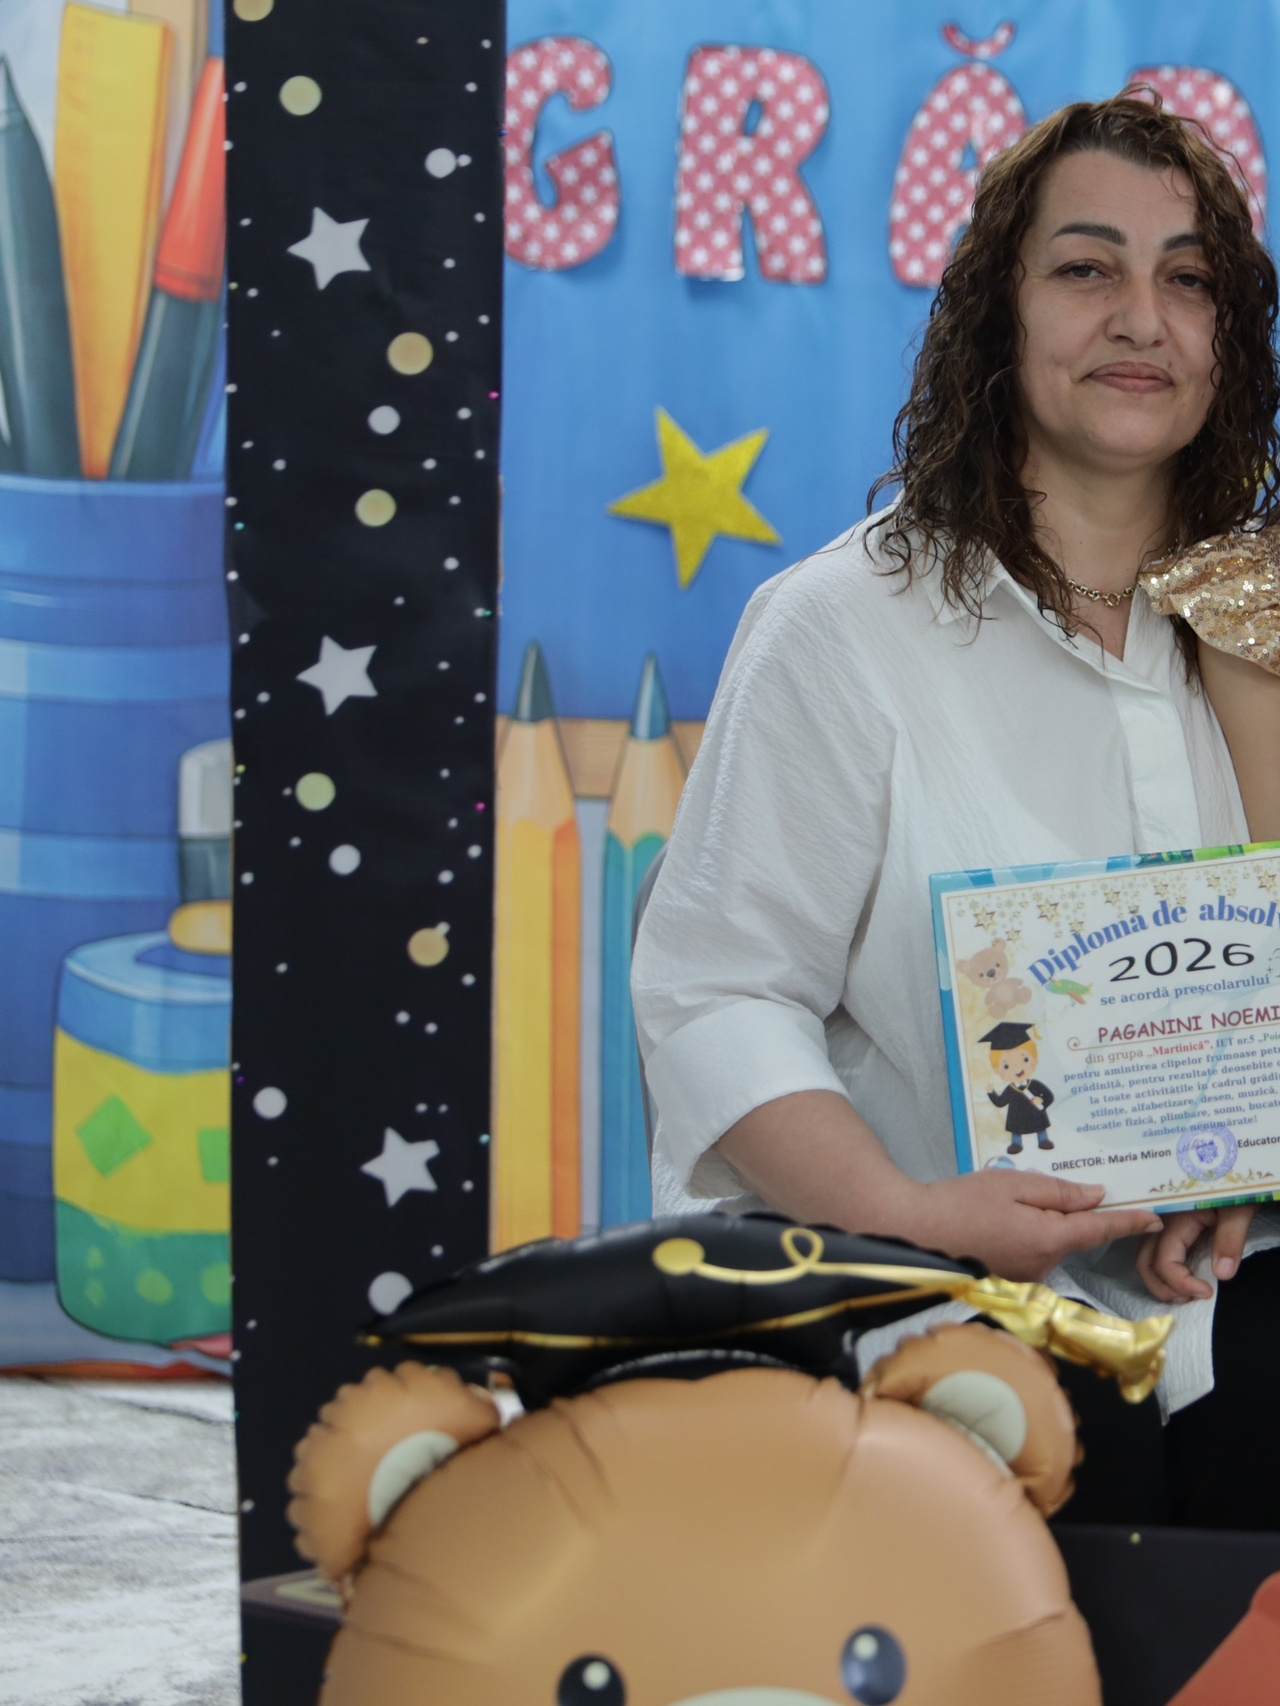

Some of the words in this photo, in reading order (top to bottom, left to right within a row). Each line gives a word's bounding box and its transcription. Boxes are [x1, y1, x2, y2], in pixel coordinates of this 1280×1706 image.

[1152, 899, 1187, 926] de
[1109, 937, 1254, 982] 2026
[1100, 994, 1116, 1006] se
[1121, 987, 1170, 1004] acordă
[1098, 1015, 1203, 1043] PAGANINI
[1211, 1005, 1280, 1029] NOEMI
[1085, 1053, 1104, 1065] din
[1108, 1049, 1143, 1063] grupa
[1216, 1038, 1234, 1048] IET
[1064, 1069, 1100, 1083] pentru
[1104, 1063, 1157, 1076] amintirea
[1161, 1056, 1203, 1069] clipelor
[1206, 1050, 1257, 1063] frumoase
[1128, 1074, 1165, 1088] pentru
[1168, 1067, 1217, 1081] rezultate
[1221, 1060, 1273, 1074] deosebite
[1089, 1095, 1100, 1105] la
[1103, 1092, 1132, 1103] toate
[1211, 1076, 1246, 1089] cadrul
[1051, 1156, 1106, 1171] DIRECTOR:
[1108, 1153, 1138, 1164] Maria
[1141, 1149, 1171, 1160] Miron
